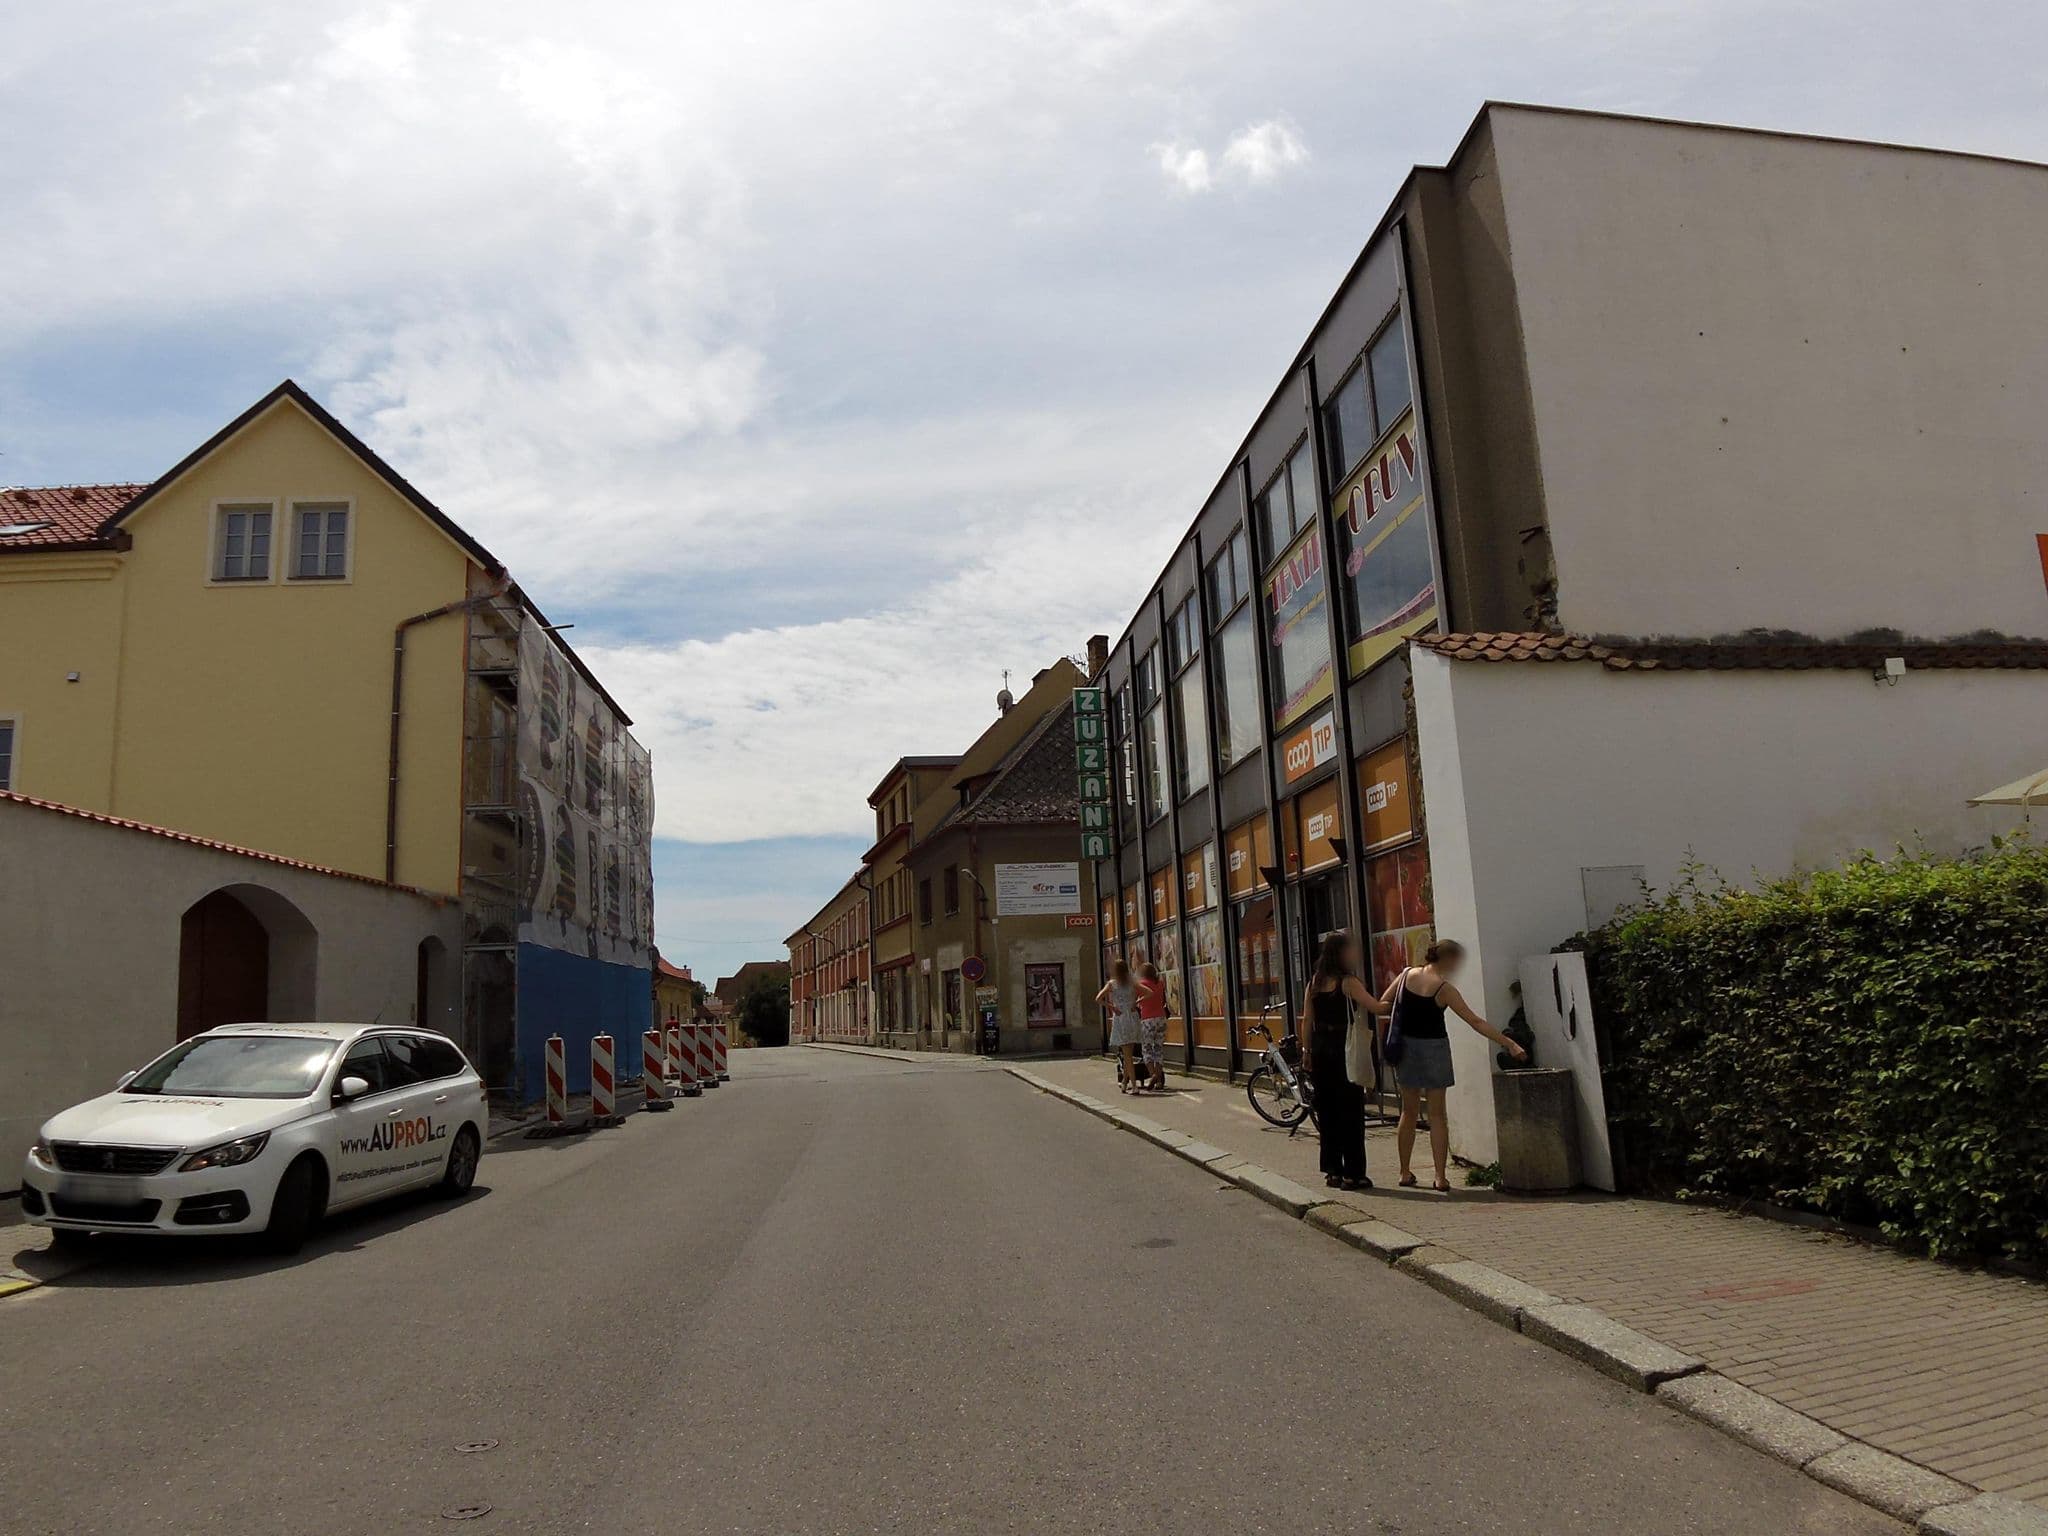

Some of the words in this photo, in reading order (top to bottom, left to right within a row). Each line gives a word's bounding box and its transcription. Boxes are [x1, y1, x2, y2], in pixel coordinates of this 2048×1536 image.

[1348, 429, 1418, 535] OBUV
[1314, 725, 1332, 754] TIP
[1079, 691, 1104, 856] ZUZANA
[1387, 782, 1398, 798] TIP
[986, 1012, 993, 1021] P
